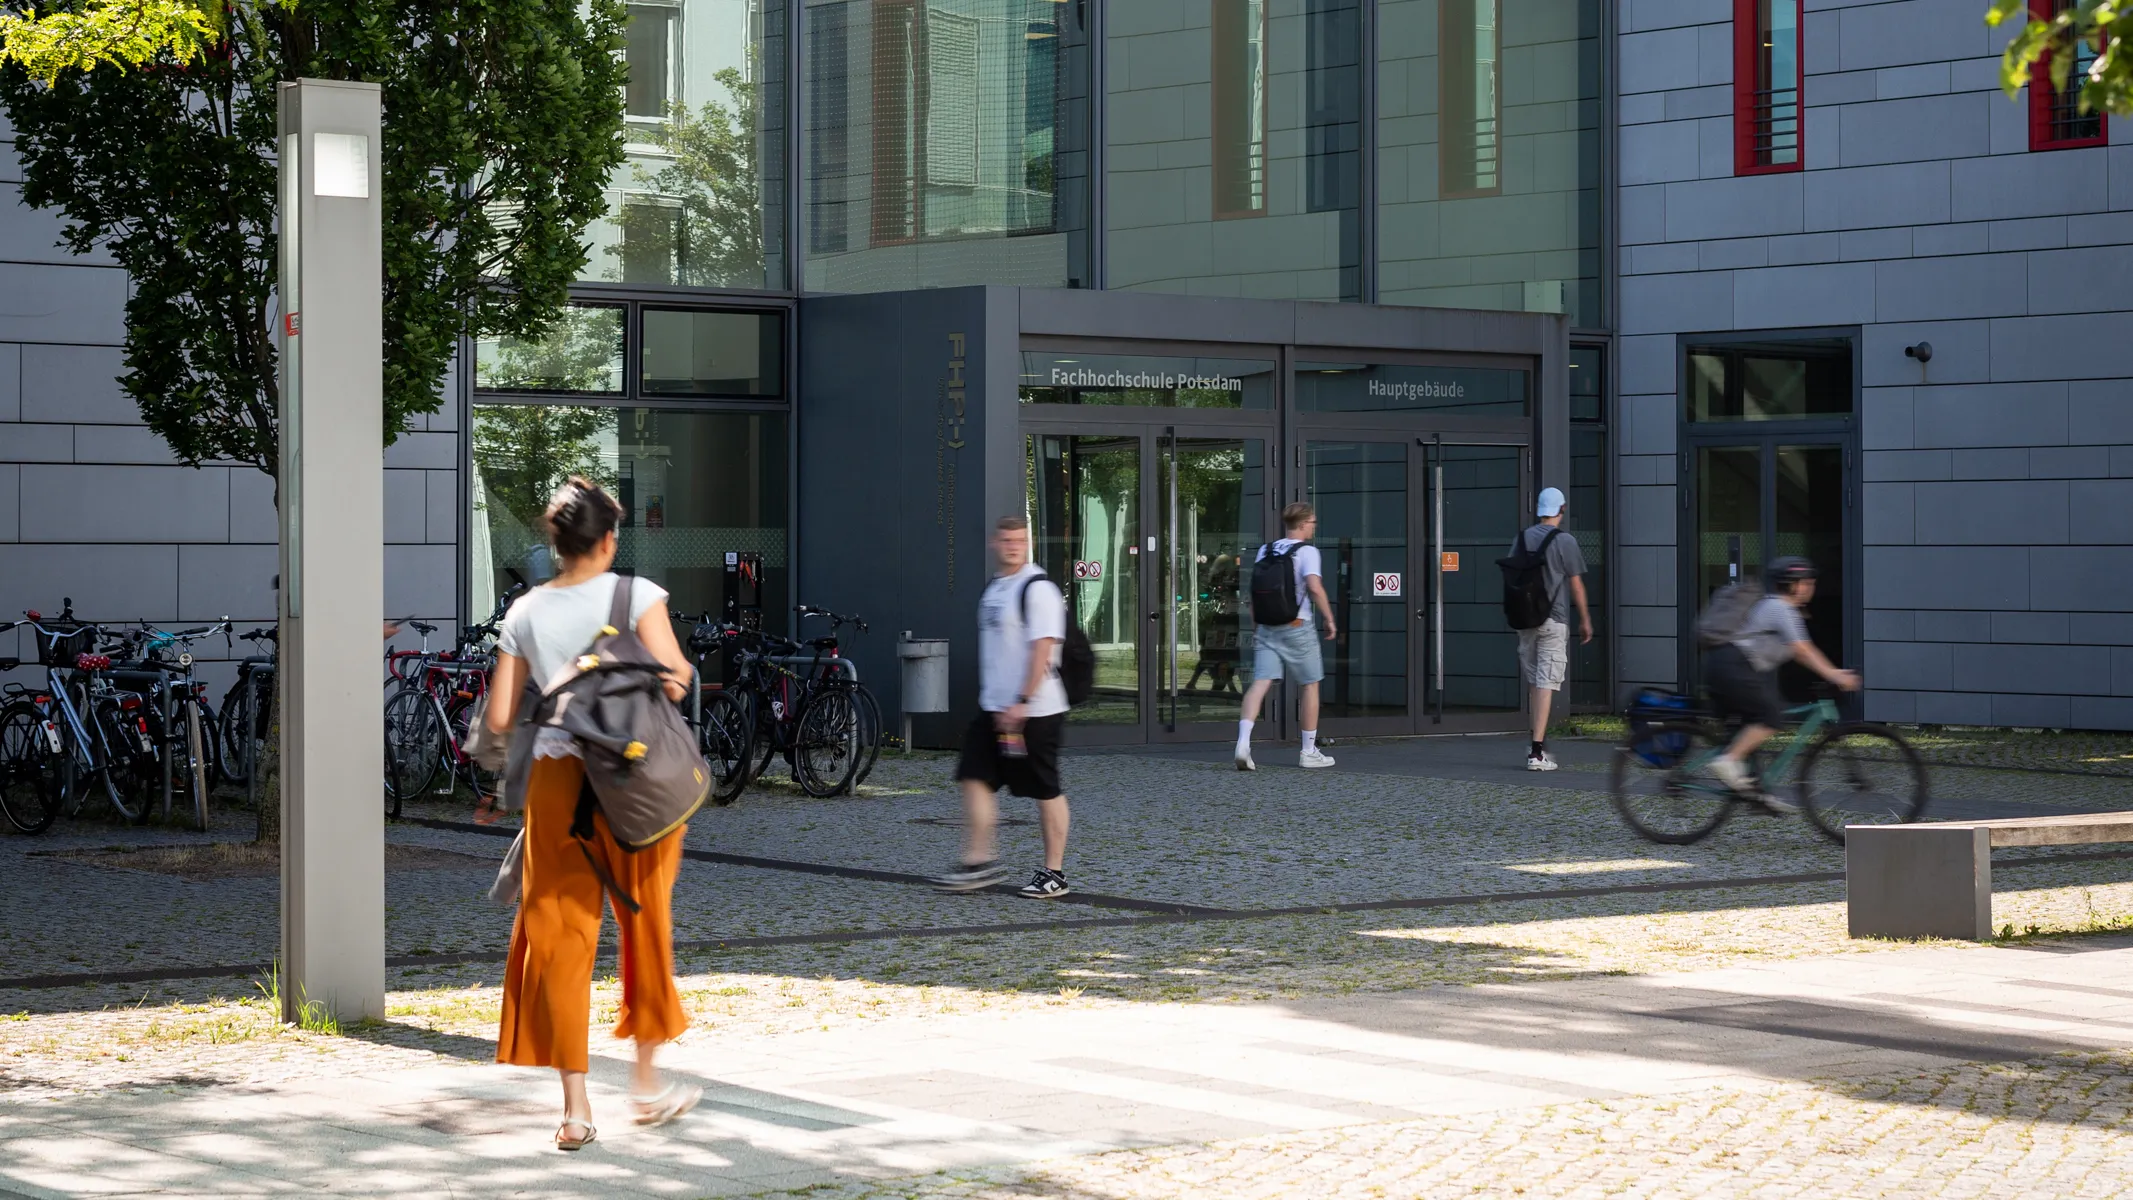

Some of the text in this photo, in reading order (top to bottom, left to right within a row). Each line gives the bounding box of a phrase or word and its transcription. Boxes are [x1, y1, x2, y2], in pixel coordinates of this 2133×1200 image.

[1051, 367, 1242, 391] Fachhochschule Potsdam
[1369, 379, 1464, 401] Hauptgebäude
